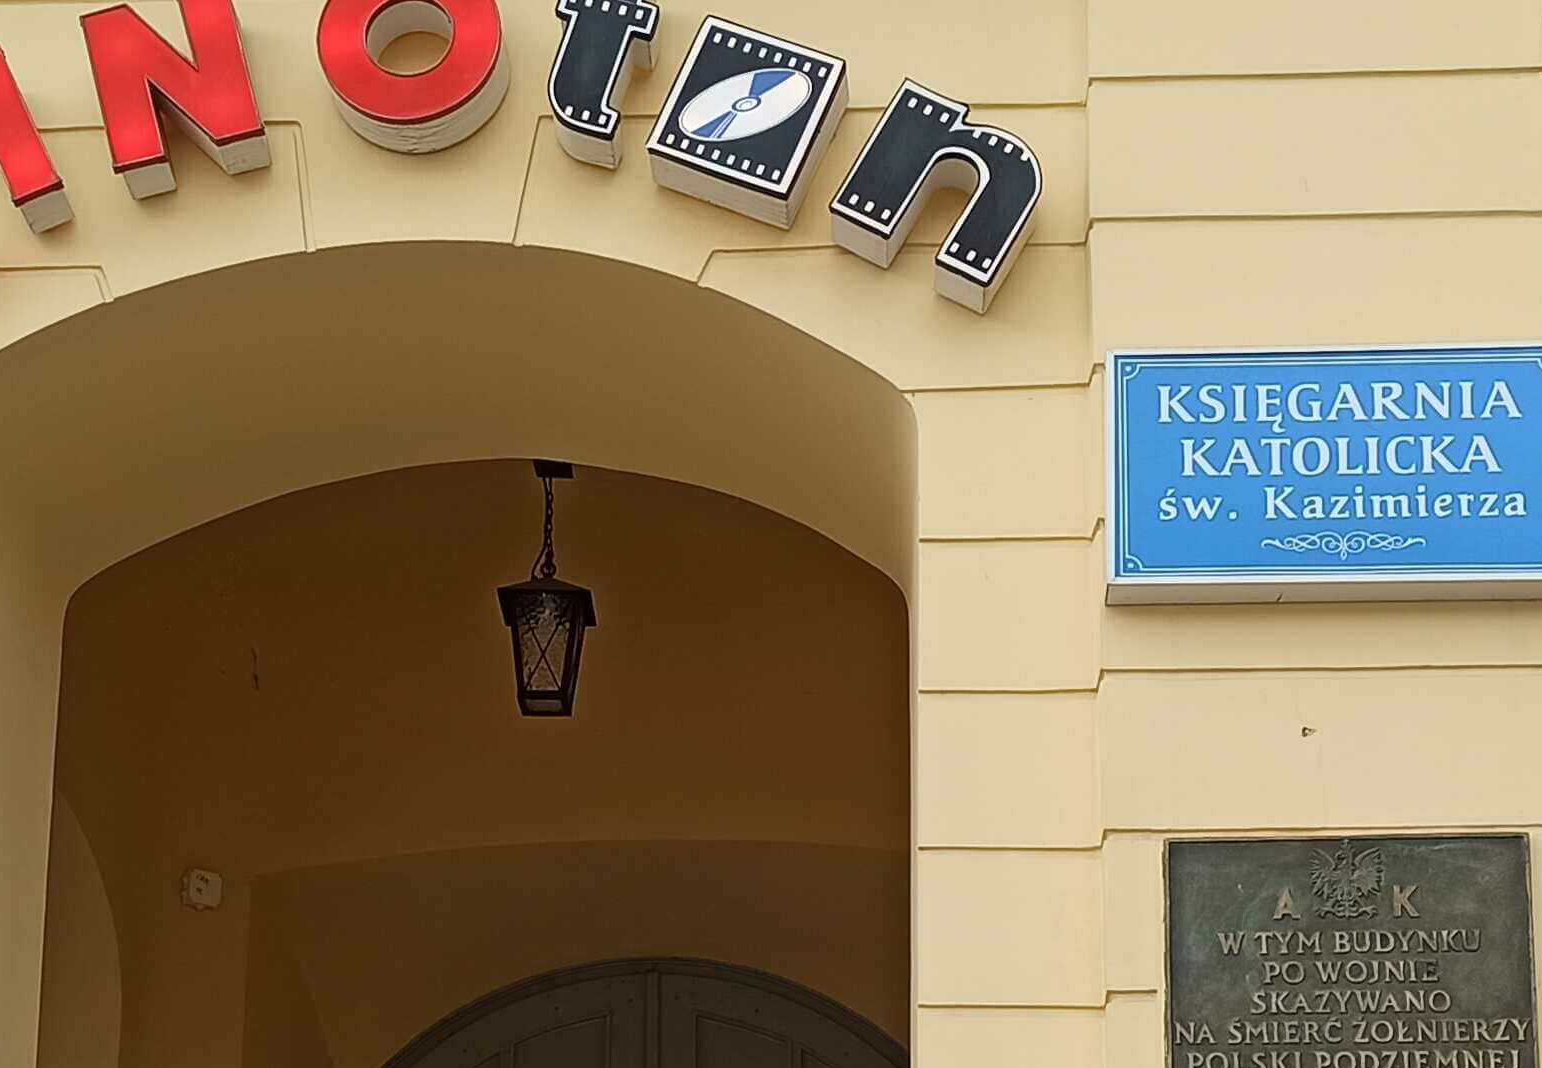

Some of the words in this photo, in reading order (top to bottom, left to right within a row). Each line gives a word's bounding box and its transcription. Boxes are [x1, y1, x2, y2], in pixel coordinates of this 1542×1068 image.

[1157, 379, 1523, 433] KSIĘGARNIA
[1180, 434, 1503, 477] KATOLICKA
[1159, 488, 1238, 521] św.
[1264, 484, 1527, 520] Kazimierza
[1272, 886, 1301, 920] A
[1392, 884, 1421, 918] K
[1217, 932, 1246, 955] W
[1255, 931, 1322, 954] TYM
[1333, 929, 1482, 953] BUDYNKU
[1263, 962, 1305, 984] PO
[1316, 960, 1440, 983] WOJNIE
[1250, 989, 1453, 1014] SKAZYWANO
[1174, 1021, 1216, 1045] NA
[1228, 1018, 1343, 1044] ŚMIERĆ
[1353, 1017, 1531, 1043] ŻOŁNIERZY
